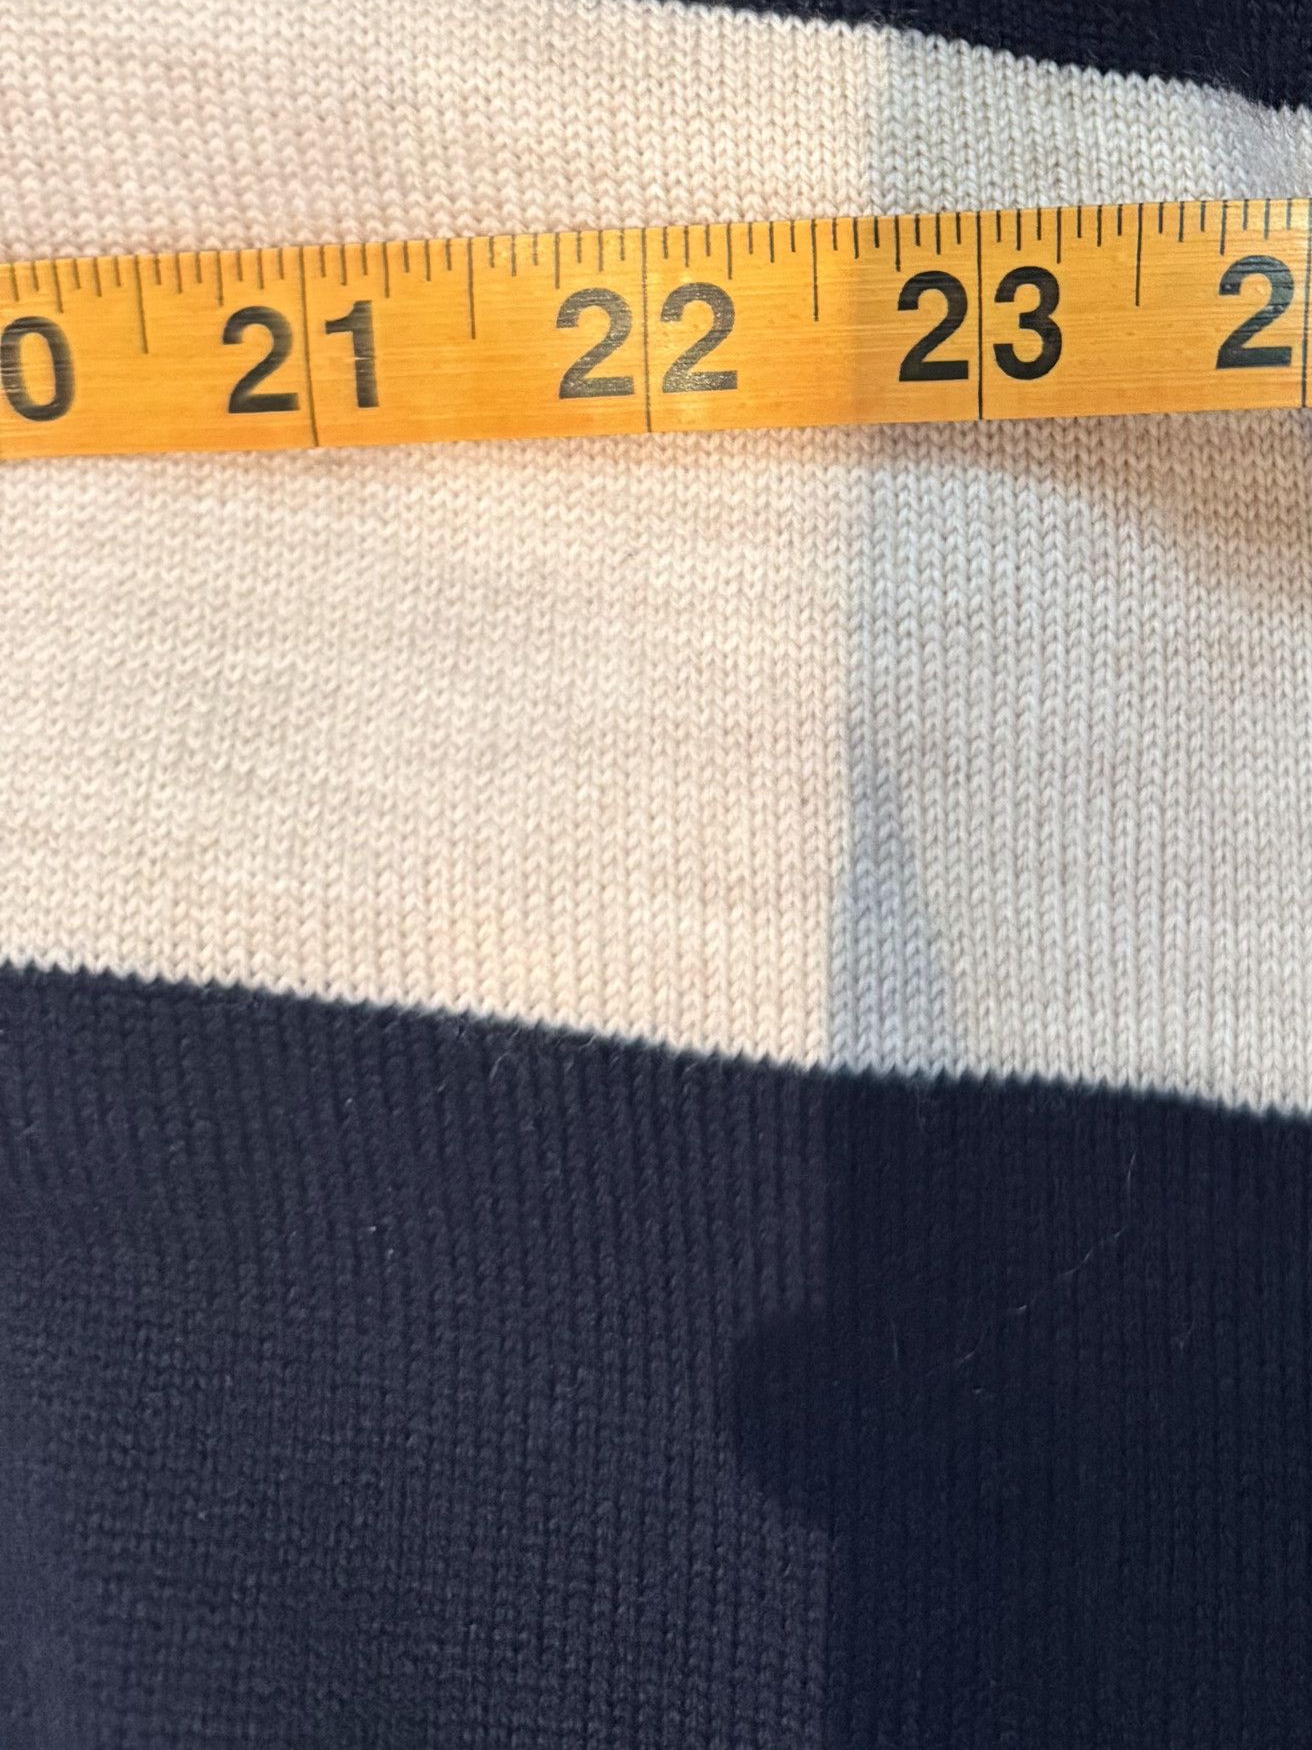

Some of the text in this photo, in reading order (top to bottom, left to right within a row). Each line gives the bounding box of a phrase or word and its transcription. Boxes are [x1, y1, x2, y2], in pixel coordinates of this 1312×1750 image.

[0, 315, 76, 423] 0
[221, 298, 381, 415] 21
[554, 281, 739, 400] 22
[896, 265, 1064, 383] 23
